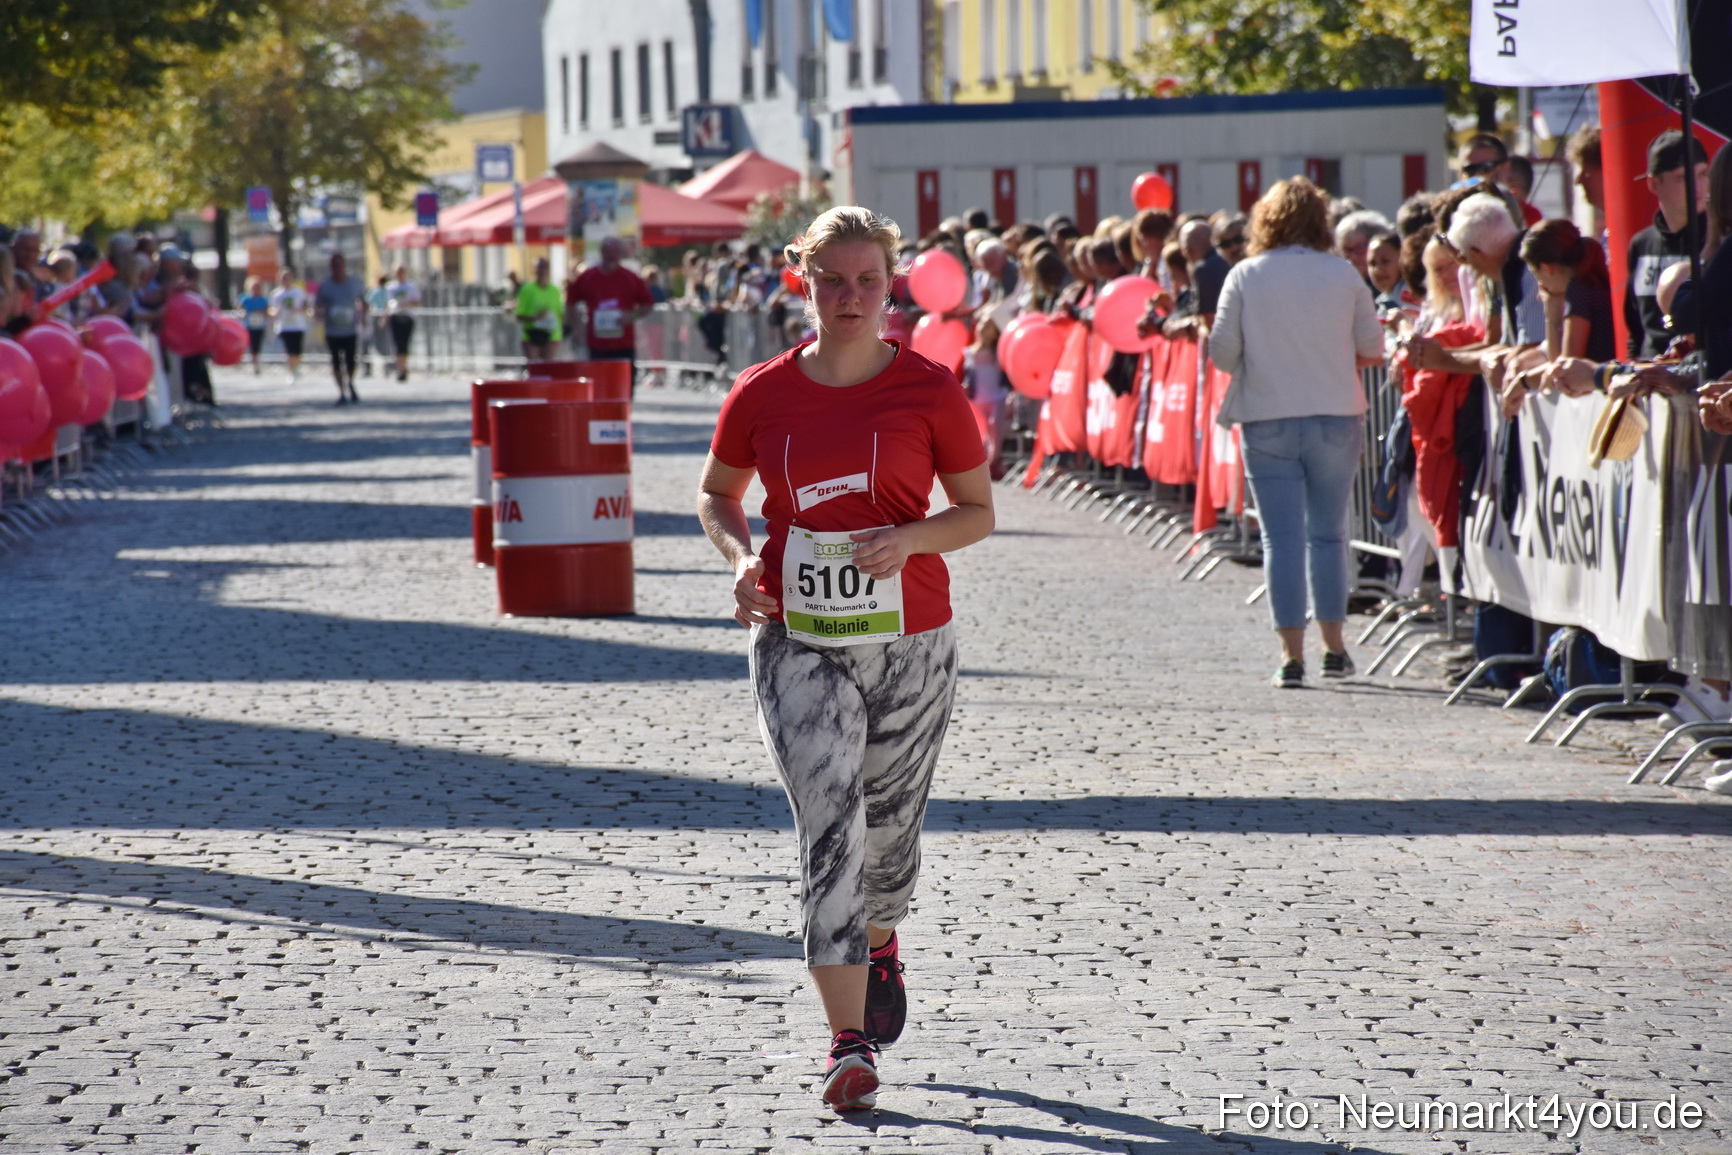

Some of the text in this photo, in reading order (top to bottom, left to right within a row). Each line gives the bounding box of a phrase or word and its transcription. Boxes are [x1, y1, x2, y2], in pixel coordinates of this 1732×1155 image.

[818, 483, 848, 497] DEHN
[593, 490, 632, 521] AVI
[814, 542, 862, 556] BOCK
[805, 603, 866, 612] PARTL Neumarkt
[813, 619, 869, 635] Melanie
